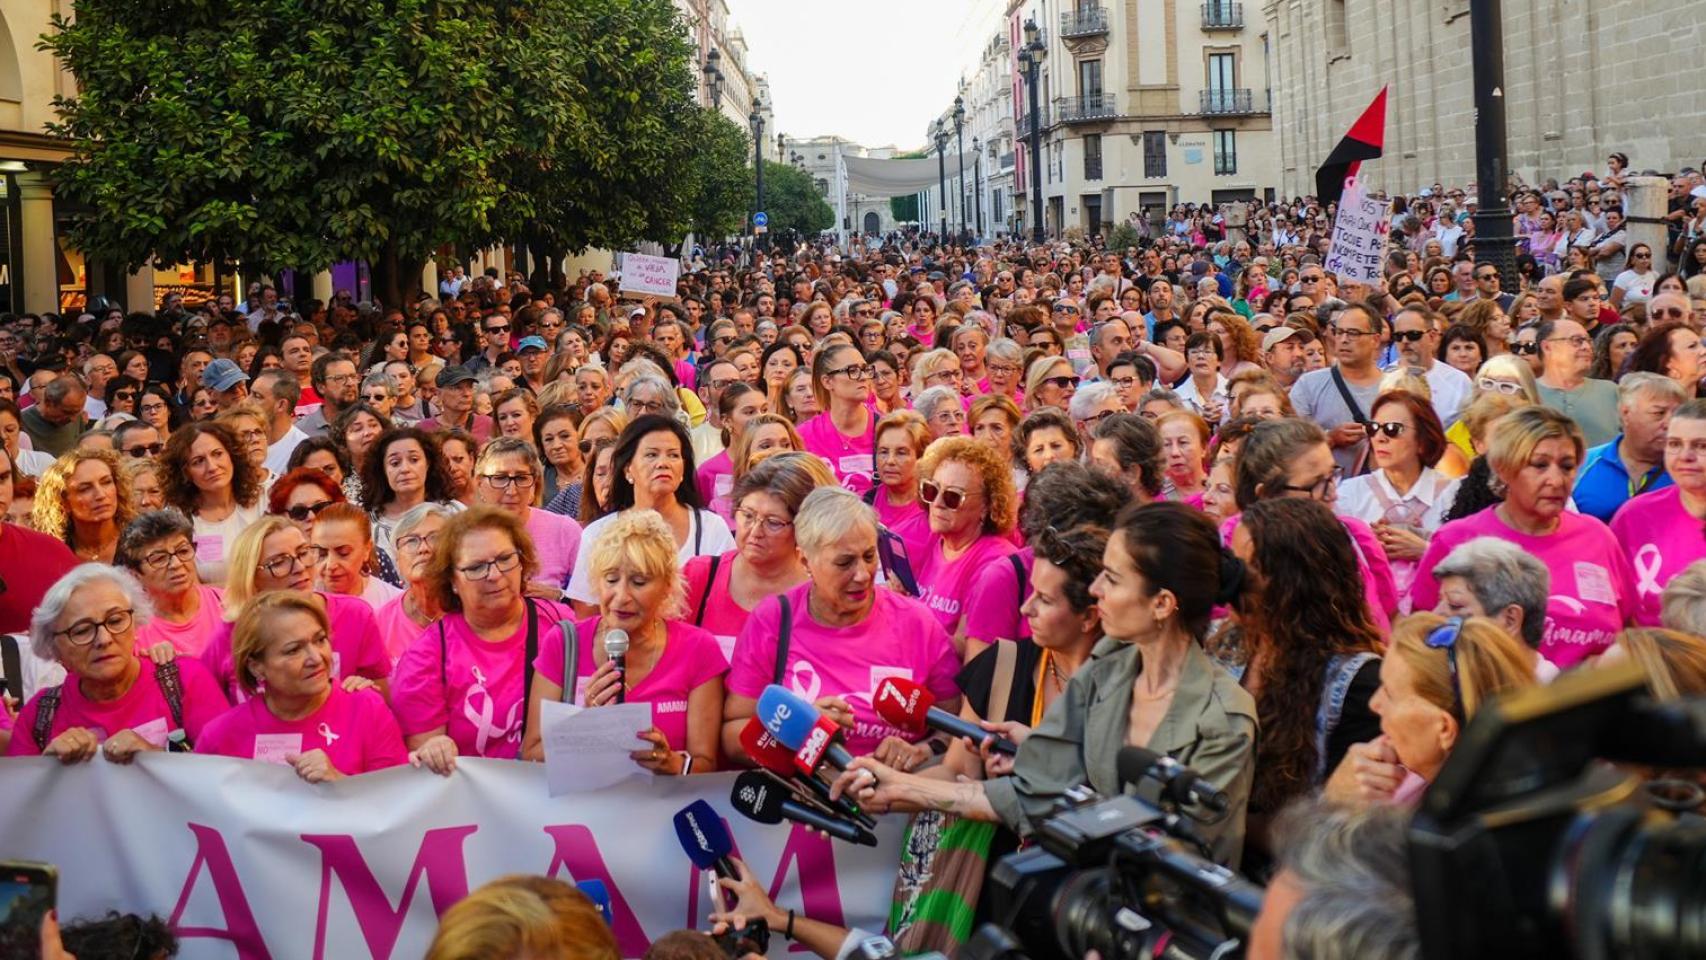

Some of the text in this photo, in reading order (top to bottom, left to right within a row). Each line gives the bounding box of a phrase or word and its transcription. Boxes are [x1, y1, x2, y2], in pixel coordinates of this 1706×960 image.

[879, 680, 907, 709] 7
[905, 688, 921, 715] siete
[767, 703, 792, 733] tve
[165, 815, 888, 960] AMAM
